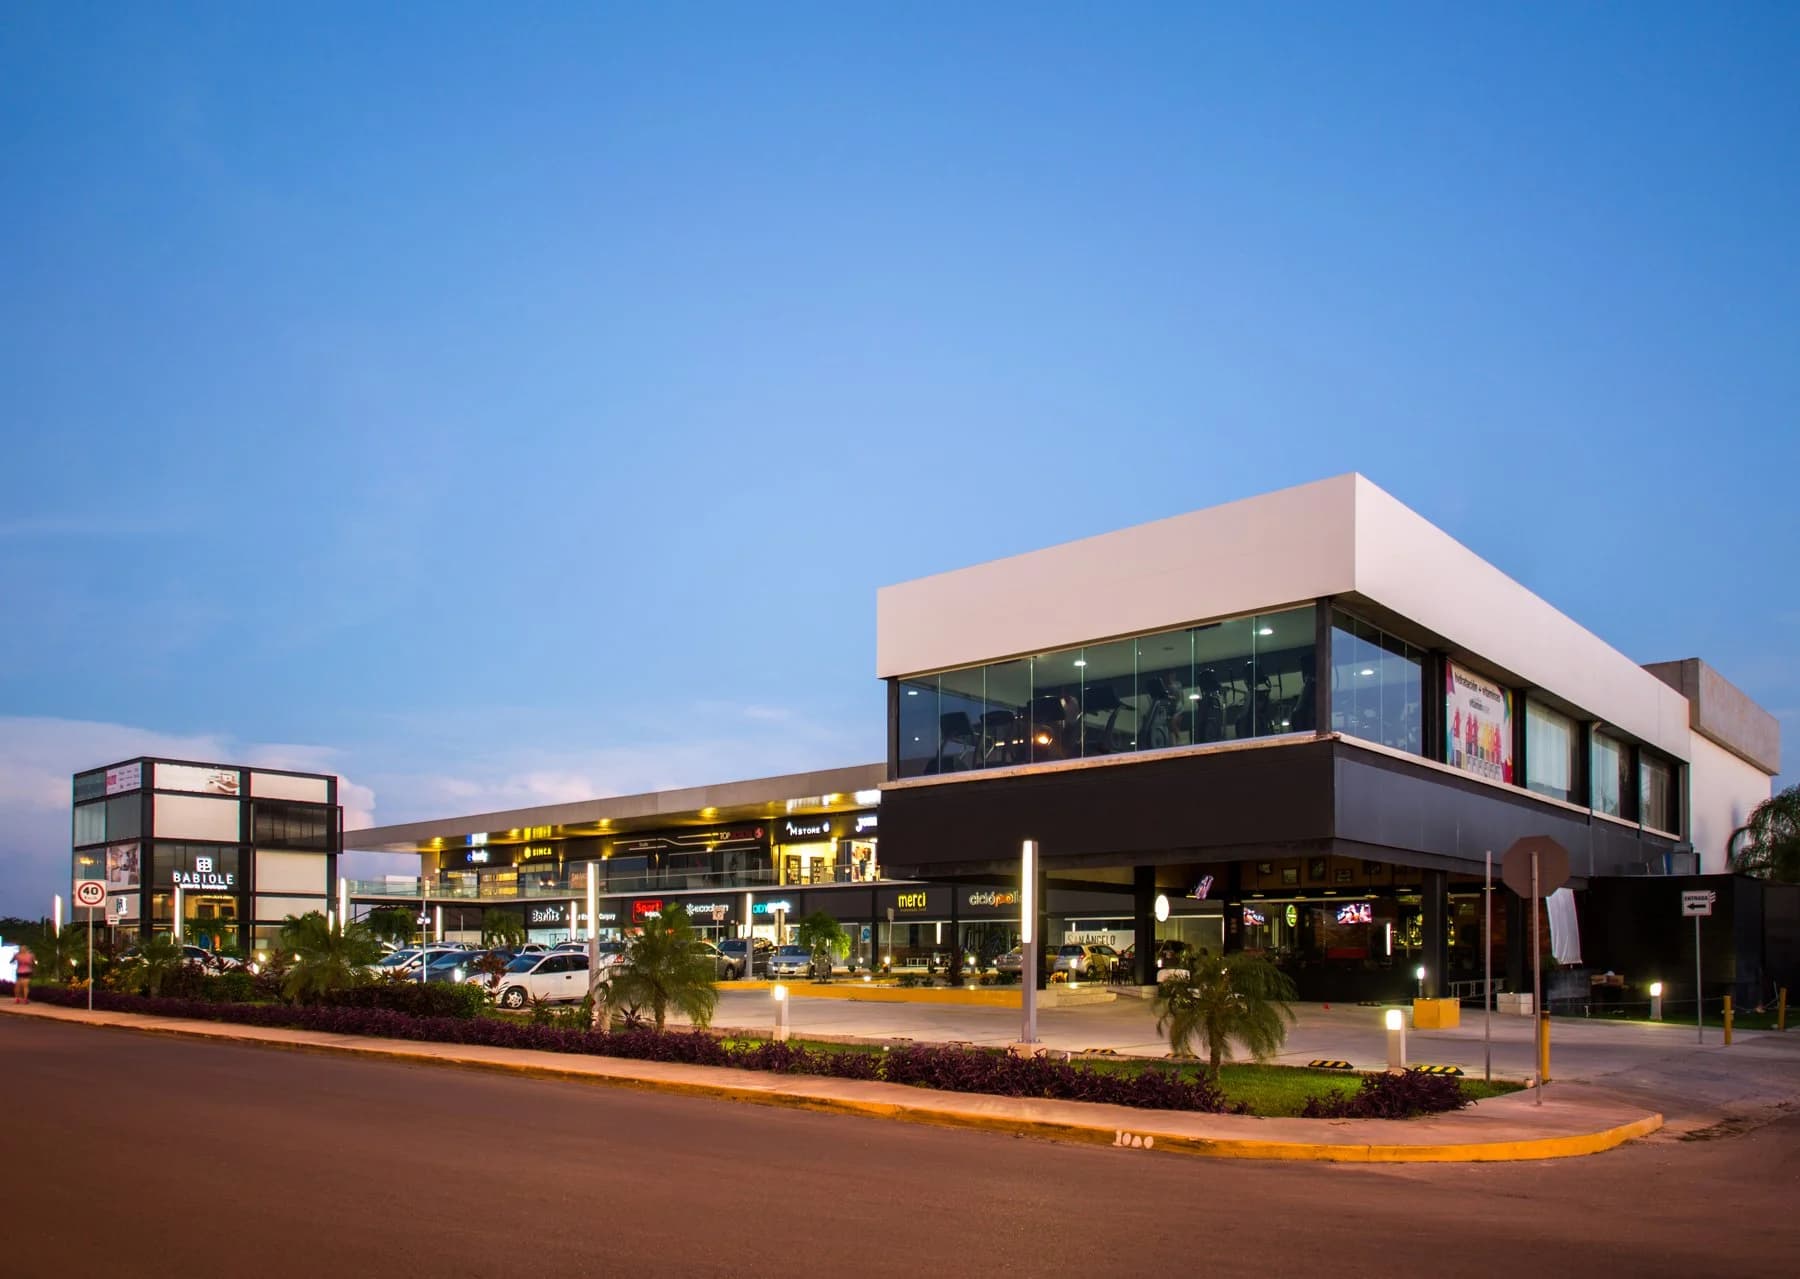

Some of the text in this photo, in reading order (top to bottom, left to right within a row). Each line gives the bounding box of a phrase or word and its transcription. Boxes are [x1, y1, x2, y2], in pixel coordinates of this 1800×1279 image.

[173, 871, 234, 885] BABIOLE
[82, 886, 99, 896] 40
[898, 892, 926, 908] merci
